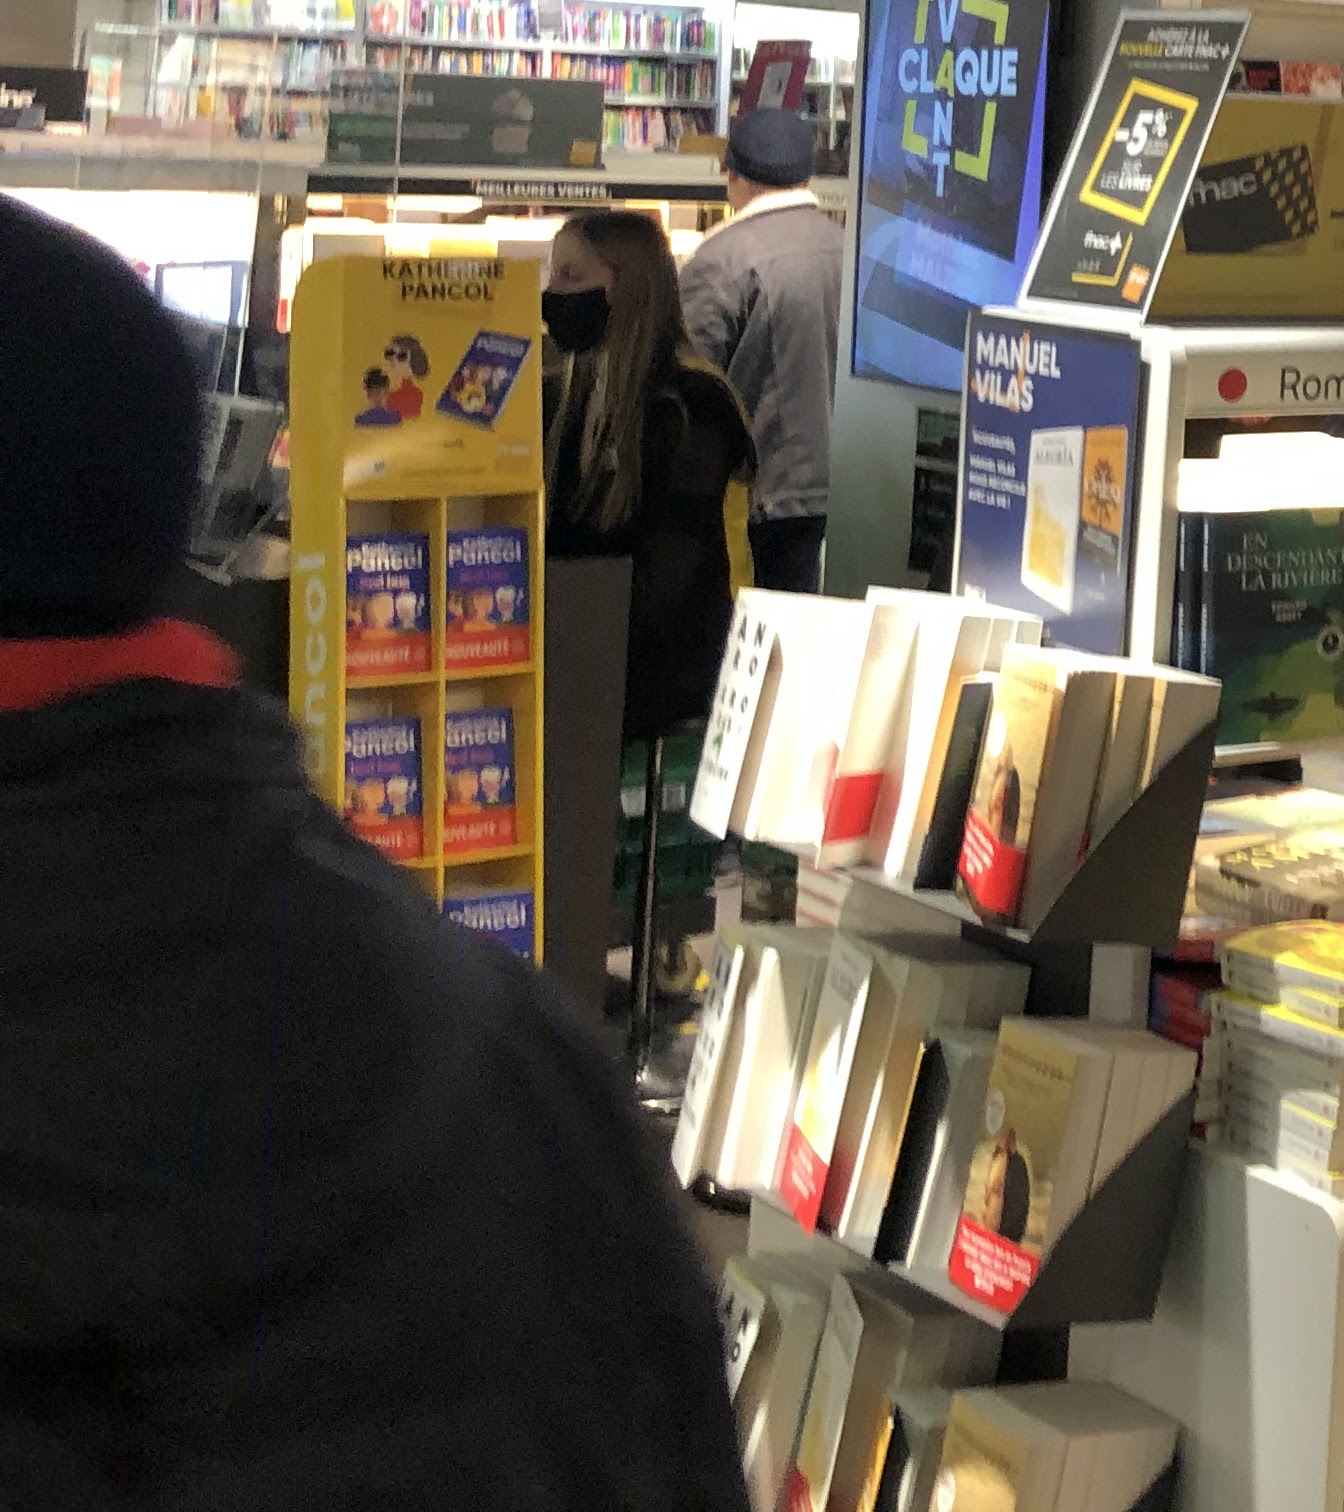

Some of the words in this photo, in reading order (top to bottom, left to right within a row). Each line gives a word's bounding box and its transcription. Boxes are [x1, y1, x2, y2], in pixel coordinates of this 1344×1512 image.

[899, 48, 1019, 98] CLAQUE
[382, 257, 506, 281] KATHERINE
[399, 282, 496, 302] PANCOL
[976, 331, 1062, 379] MANUEL
[974, 367, 1034, 413] VILAS
[1243, 531, 1268, 550] EN
[1240, 570, 1266, 591] LA
